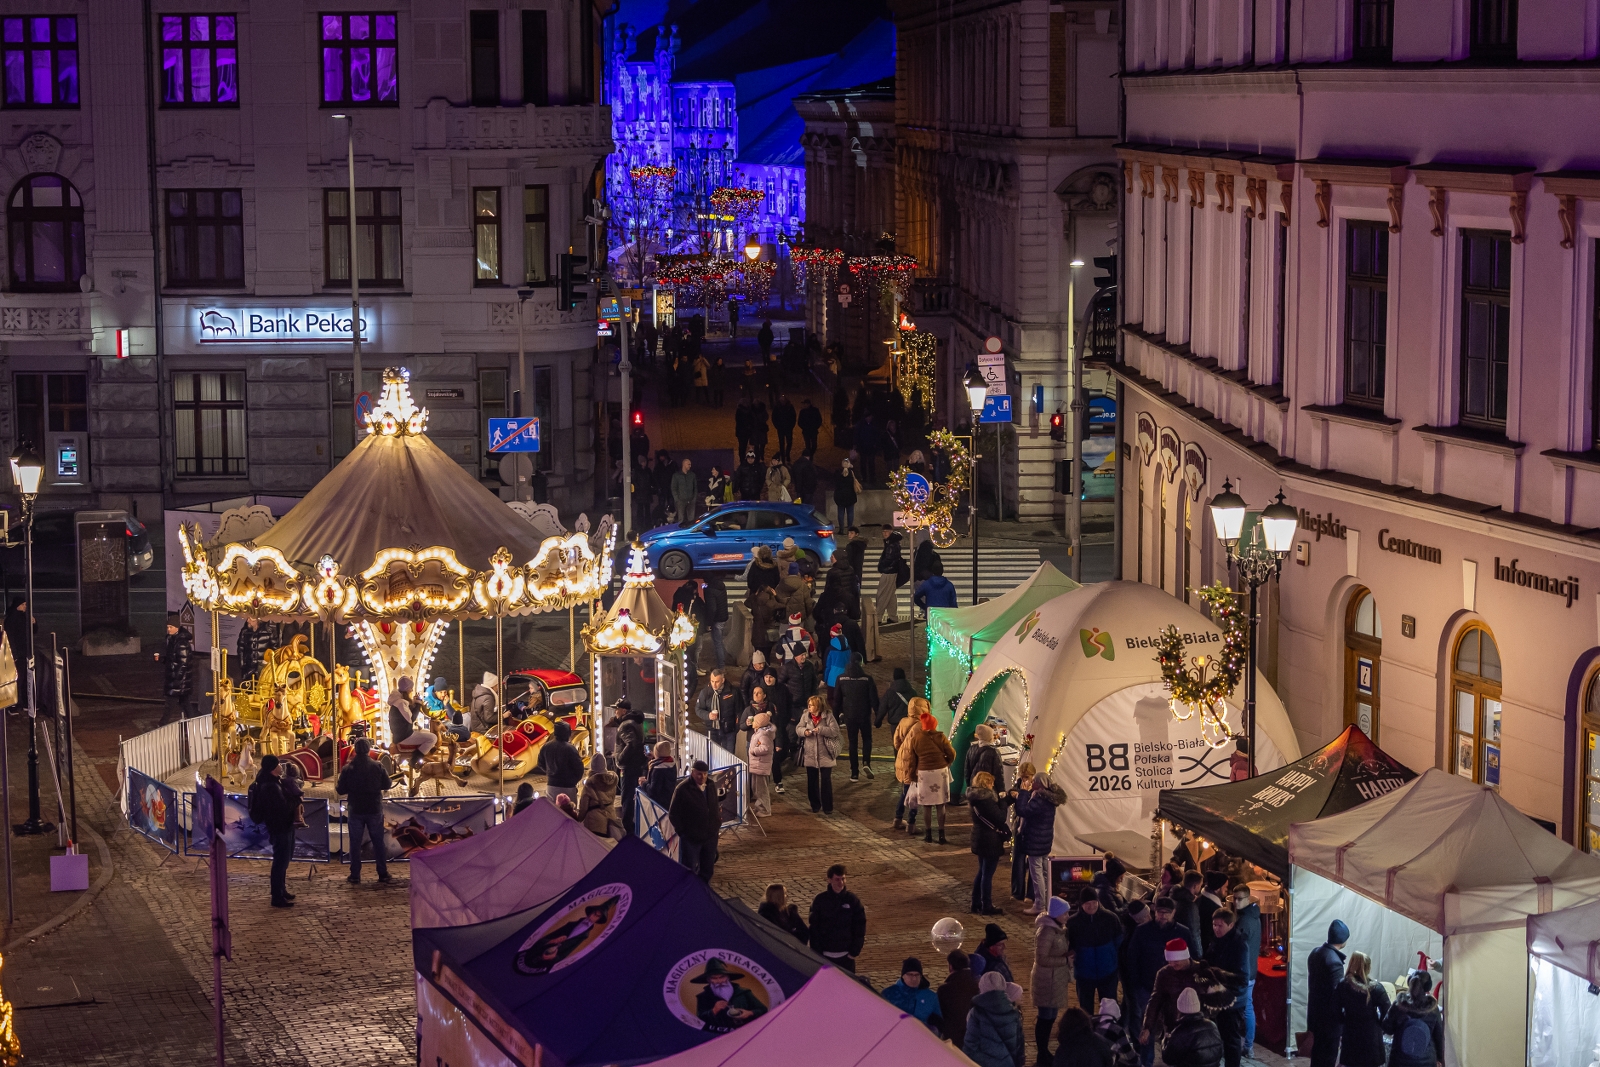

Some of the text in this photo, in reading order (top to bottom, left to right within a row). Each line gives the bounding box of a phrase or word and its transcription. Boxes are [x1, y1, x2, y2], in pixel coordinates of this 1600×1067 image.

[250, 313, 367, 333] Bank Pekao
[1378, 528, 1442, 565] Centrum
[1494, 556, 1579, 608] Informacji
[1134, 738, 1206, 753] Bielsko-Biała
[1134, 753, 1171, 765] Polska
[1135, 766, 1173, 778] Stolica
[1275, 770, 1318, 793] HAPPY
[1088, 775, 1132, 792] 2026
[1136, 779, 1176, 790] Kultury
[1252, 785, 1296, 808] HOURS
[666, 951, 775, 994] MAGICZNY STRAGAN
